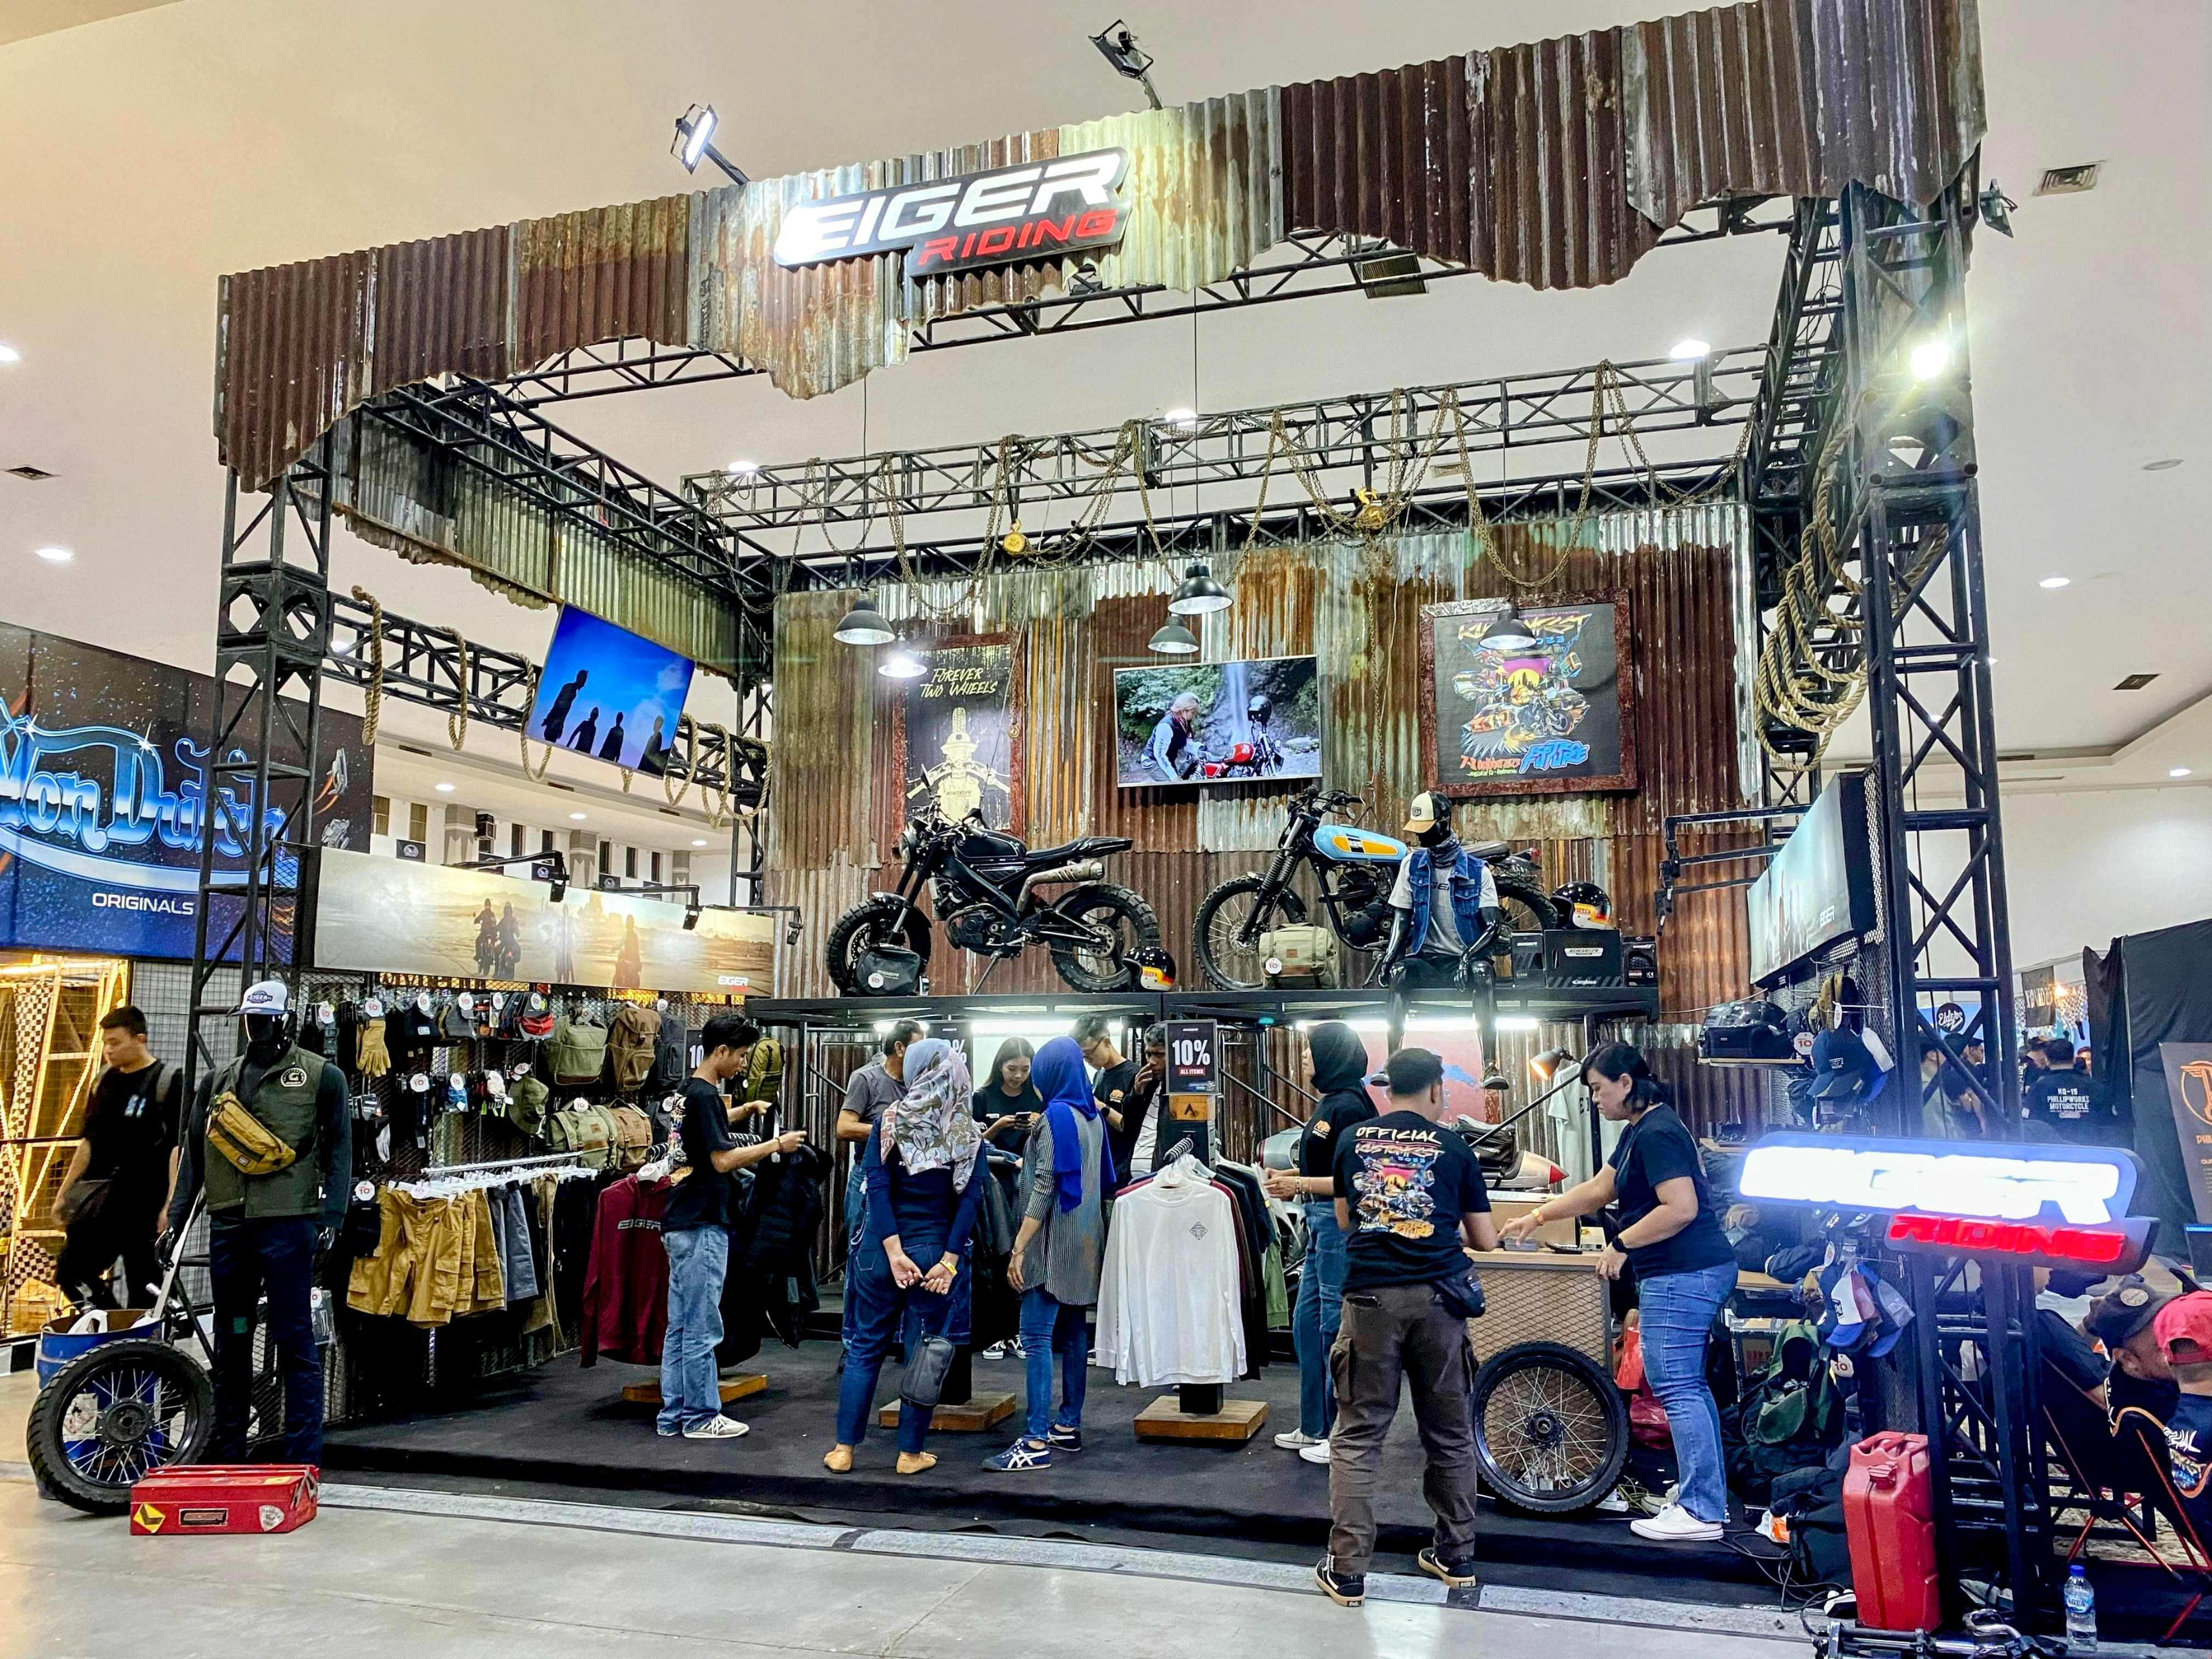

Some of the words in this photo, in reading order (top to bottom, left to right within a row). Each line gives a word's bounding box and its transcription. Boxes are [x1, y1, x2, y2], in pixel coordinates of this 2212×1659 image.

[782, 153, 1120, 263] EIGER
[918, 209, 1118, 266] RIDING
[932, 667, 984, 684] FOREVER
[919, 683, 943, 698] TWO
[949, 680, 998, 697] WHEELS
[92, 891, 194, 916] ORIGINALS
[718, 975, 749, 986] EIGER
[1938, 1009, 1963, 1026] Elders
[1172, 1039, 1210, 1066] 10%
[1356, 1126, 1442, 1145] OFFICIAL
[1889, 1214, 2126, 1262] RIDING
[1835, 1363, 1848, 1371] 10
